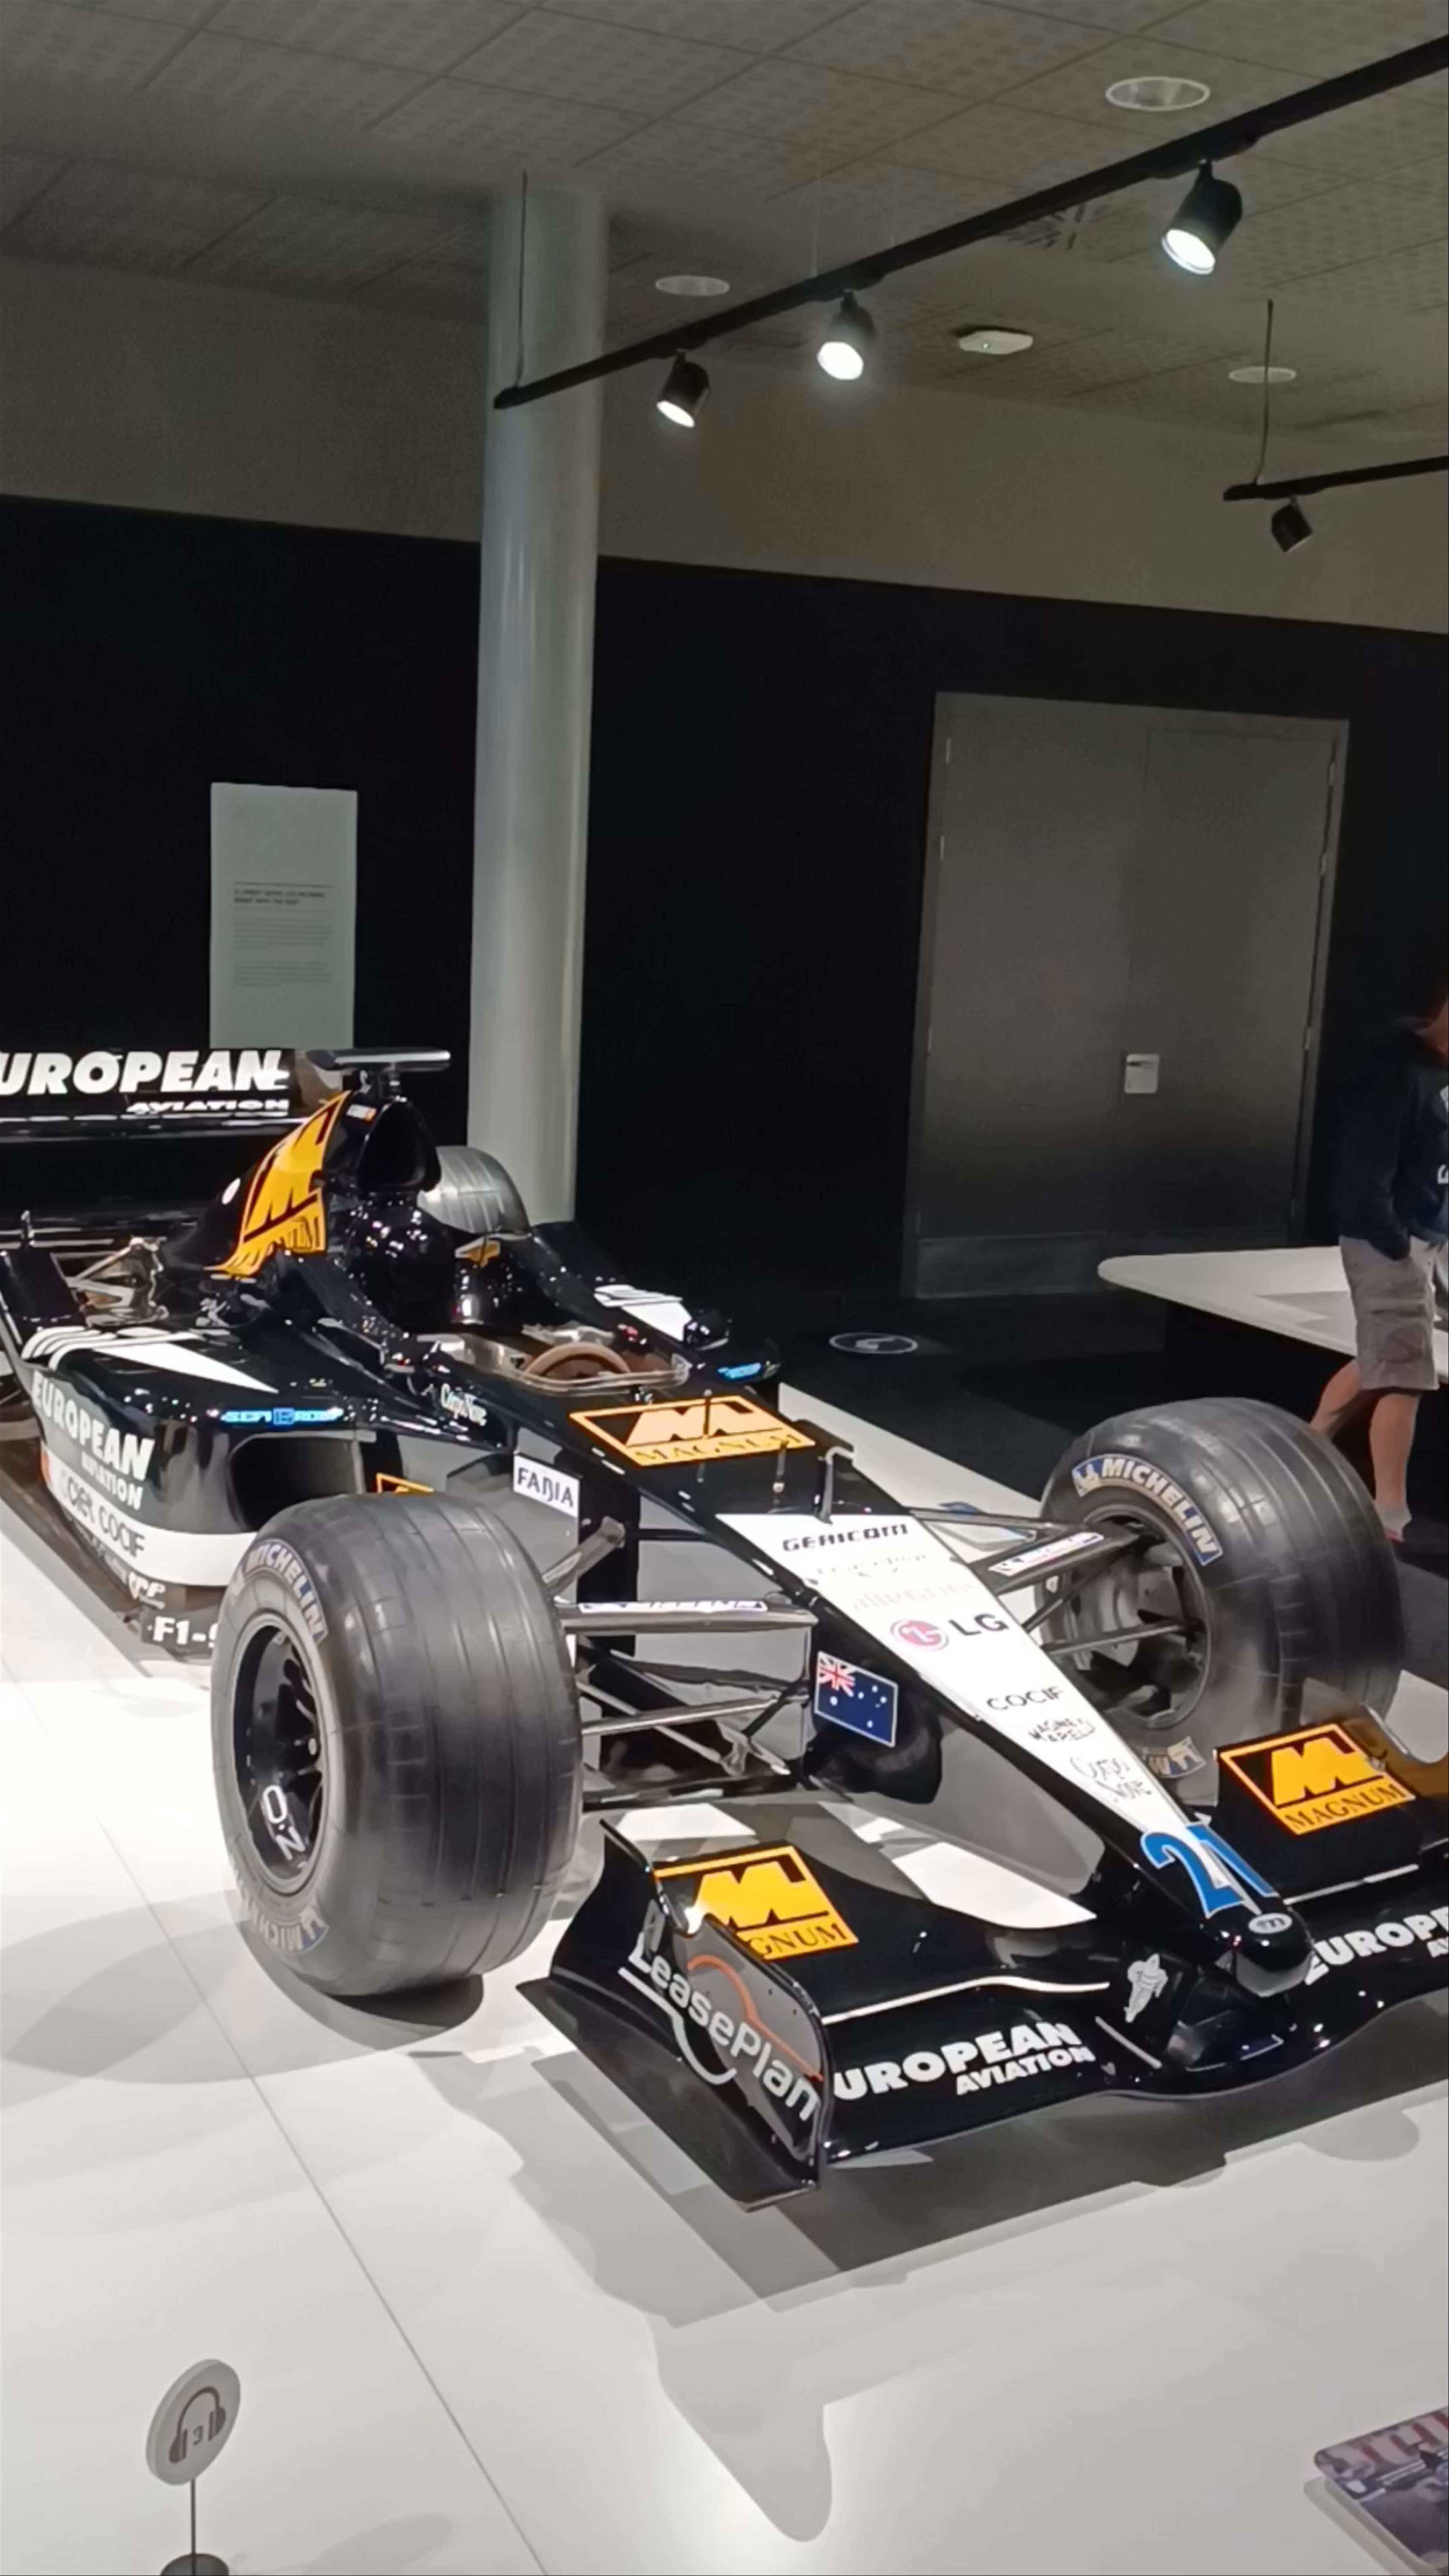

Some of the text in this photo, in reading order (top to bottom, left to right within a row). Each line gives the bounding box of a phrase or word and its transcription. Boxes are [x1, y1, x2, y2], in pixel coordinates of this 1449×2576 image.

[126, 1100, 289, 1113] AVIATION
[32, 1370, 155, 1481] EUROPEAN
[81, 1451, 143, 1511] AVIATION
[1101, 1458, 1219, 1553] MICHELIN
[245, 1543, 325, 1635] MICHELIN
[948, 1613, 1010, 1636] LG
[987, 1686, 1063, 1710] COCIF
[1285, 1784, 1407, 1830] MAGNUM
[750, 1923, 848, 1956] GNUM
[628, 1932, 821, 2121] LeasePlan
[956, 2046, 1096, 2096] AVIATION
[193, 2425, 204, 2446] 3
